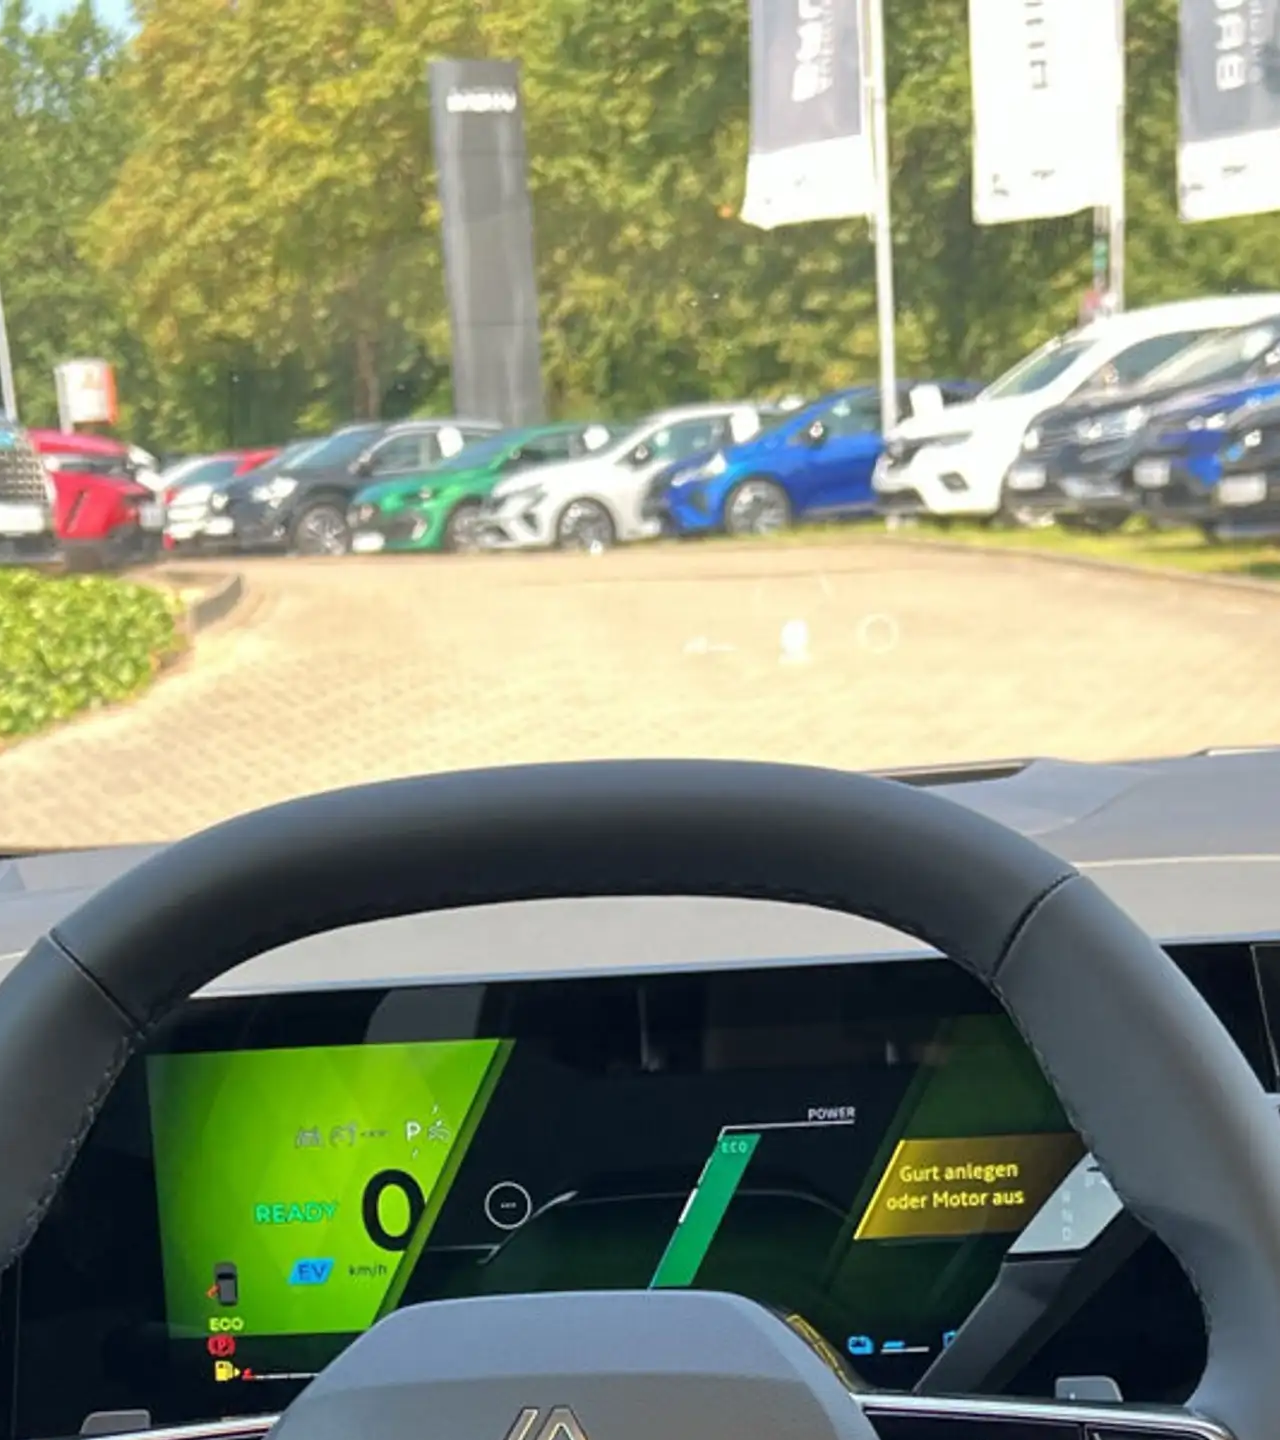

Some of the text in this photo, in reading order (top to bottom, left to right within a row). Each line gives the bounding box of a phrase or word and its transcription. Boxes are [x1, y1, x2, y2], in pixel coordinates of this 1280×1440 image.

[807, 1105, 857, 1122] POWER
[405, 1121, 421, 1141] P
[898, 1161, 1019, 1184] Gurt anlegen
[362, 1168, 428, 1252] 0
[885, 1188, 1025, 1212] oder Motor aus
[254, 1200, 337, 1224] READY
[298, 1262, 329, 1281] EV
[348, 1262, 389, 1278] km/h
[209, 1318, 245, 1331] ECO
